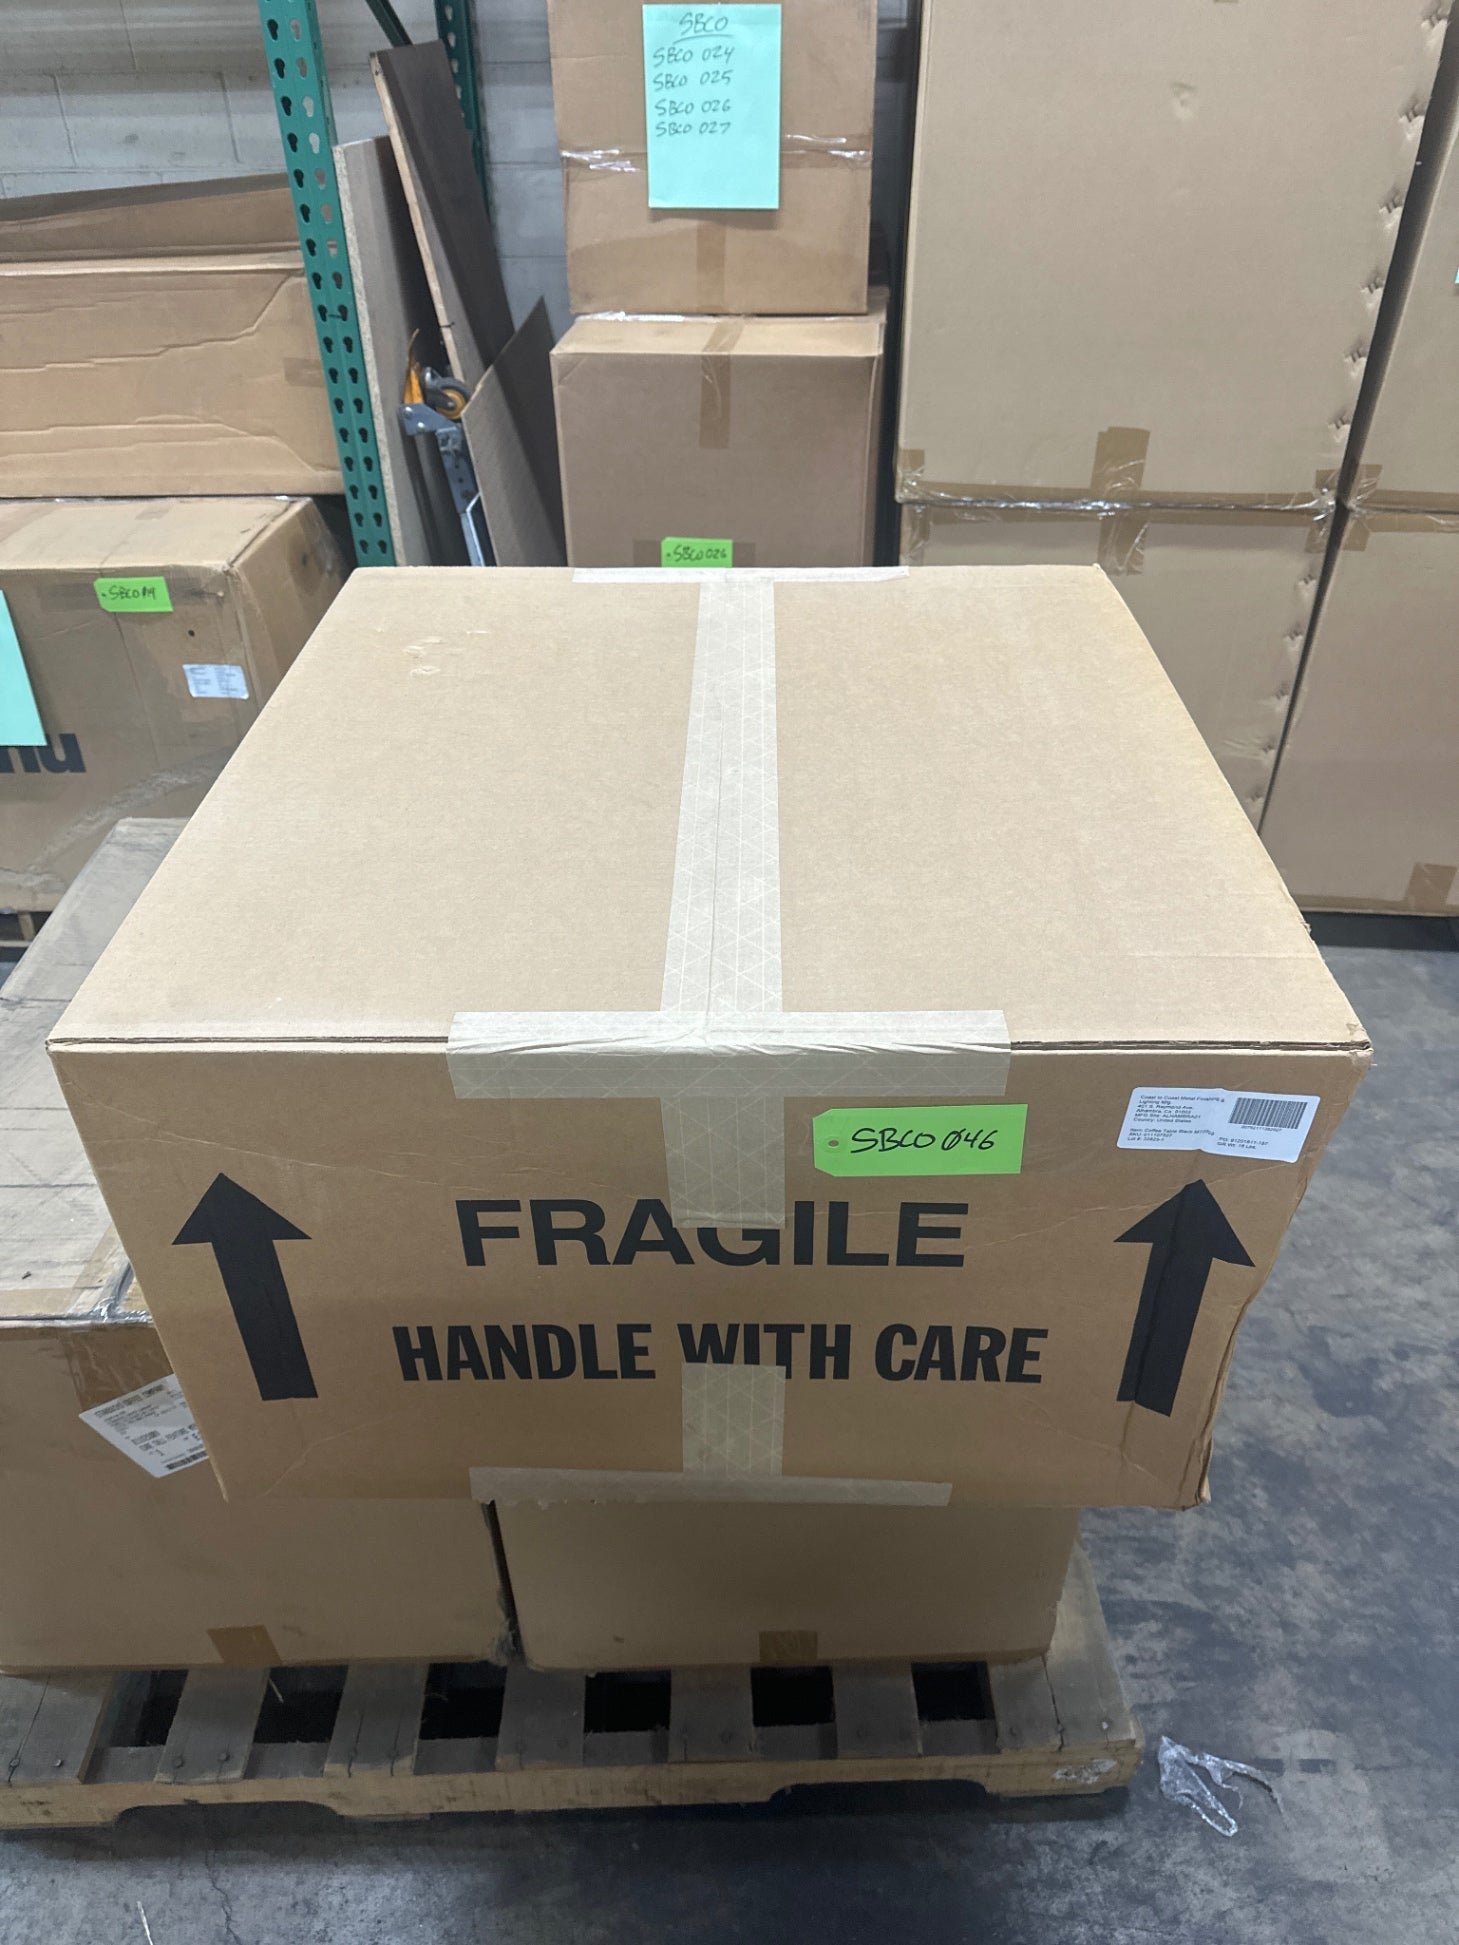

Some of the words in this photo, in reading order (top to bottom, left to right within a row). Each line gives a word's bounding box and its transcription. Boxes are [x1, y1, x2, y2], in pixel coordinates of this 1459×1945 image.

[678, 11, 729, 36] SBCO
[653, 46, 693, 68] SBCO
[702, 44, 735, 64] 024
[653, 72, 688, 91] SBCO
[700, 69, 734, 86] 025
[654, 98, 694, 116] SBCO
[701, 98, 731, 113] 026
[655, 121, 692, 137] SBCO
[699, 121, 731, 135] 027
[850, 1127, 936, 1154] SBCO
[455, 1198, 969, 1268] FRAGILE
[391, 1322, 656, 1382] HANDLE
[676, 1322, 850, 1381] WITH
[874, 1323, 1049, 1384] CARE
